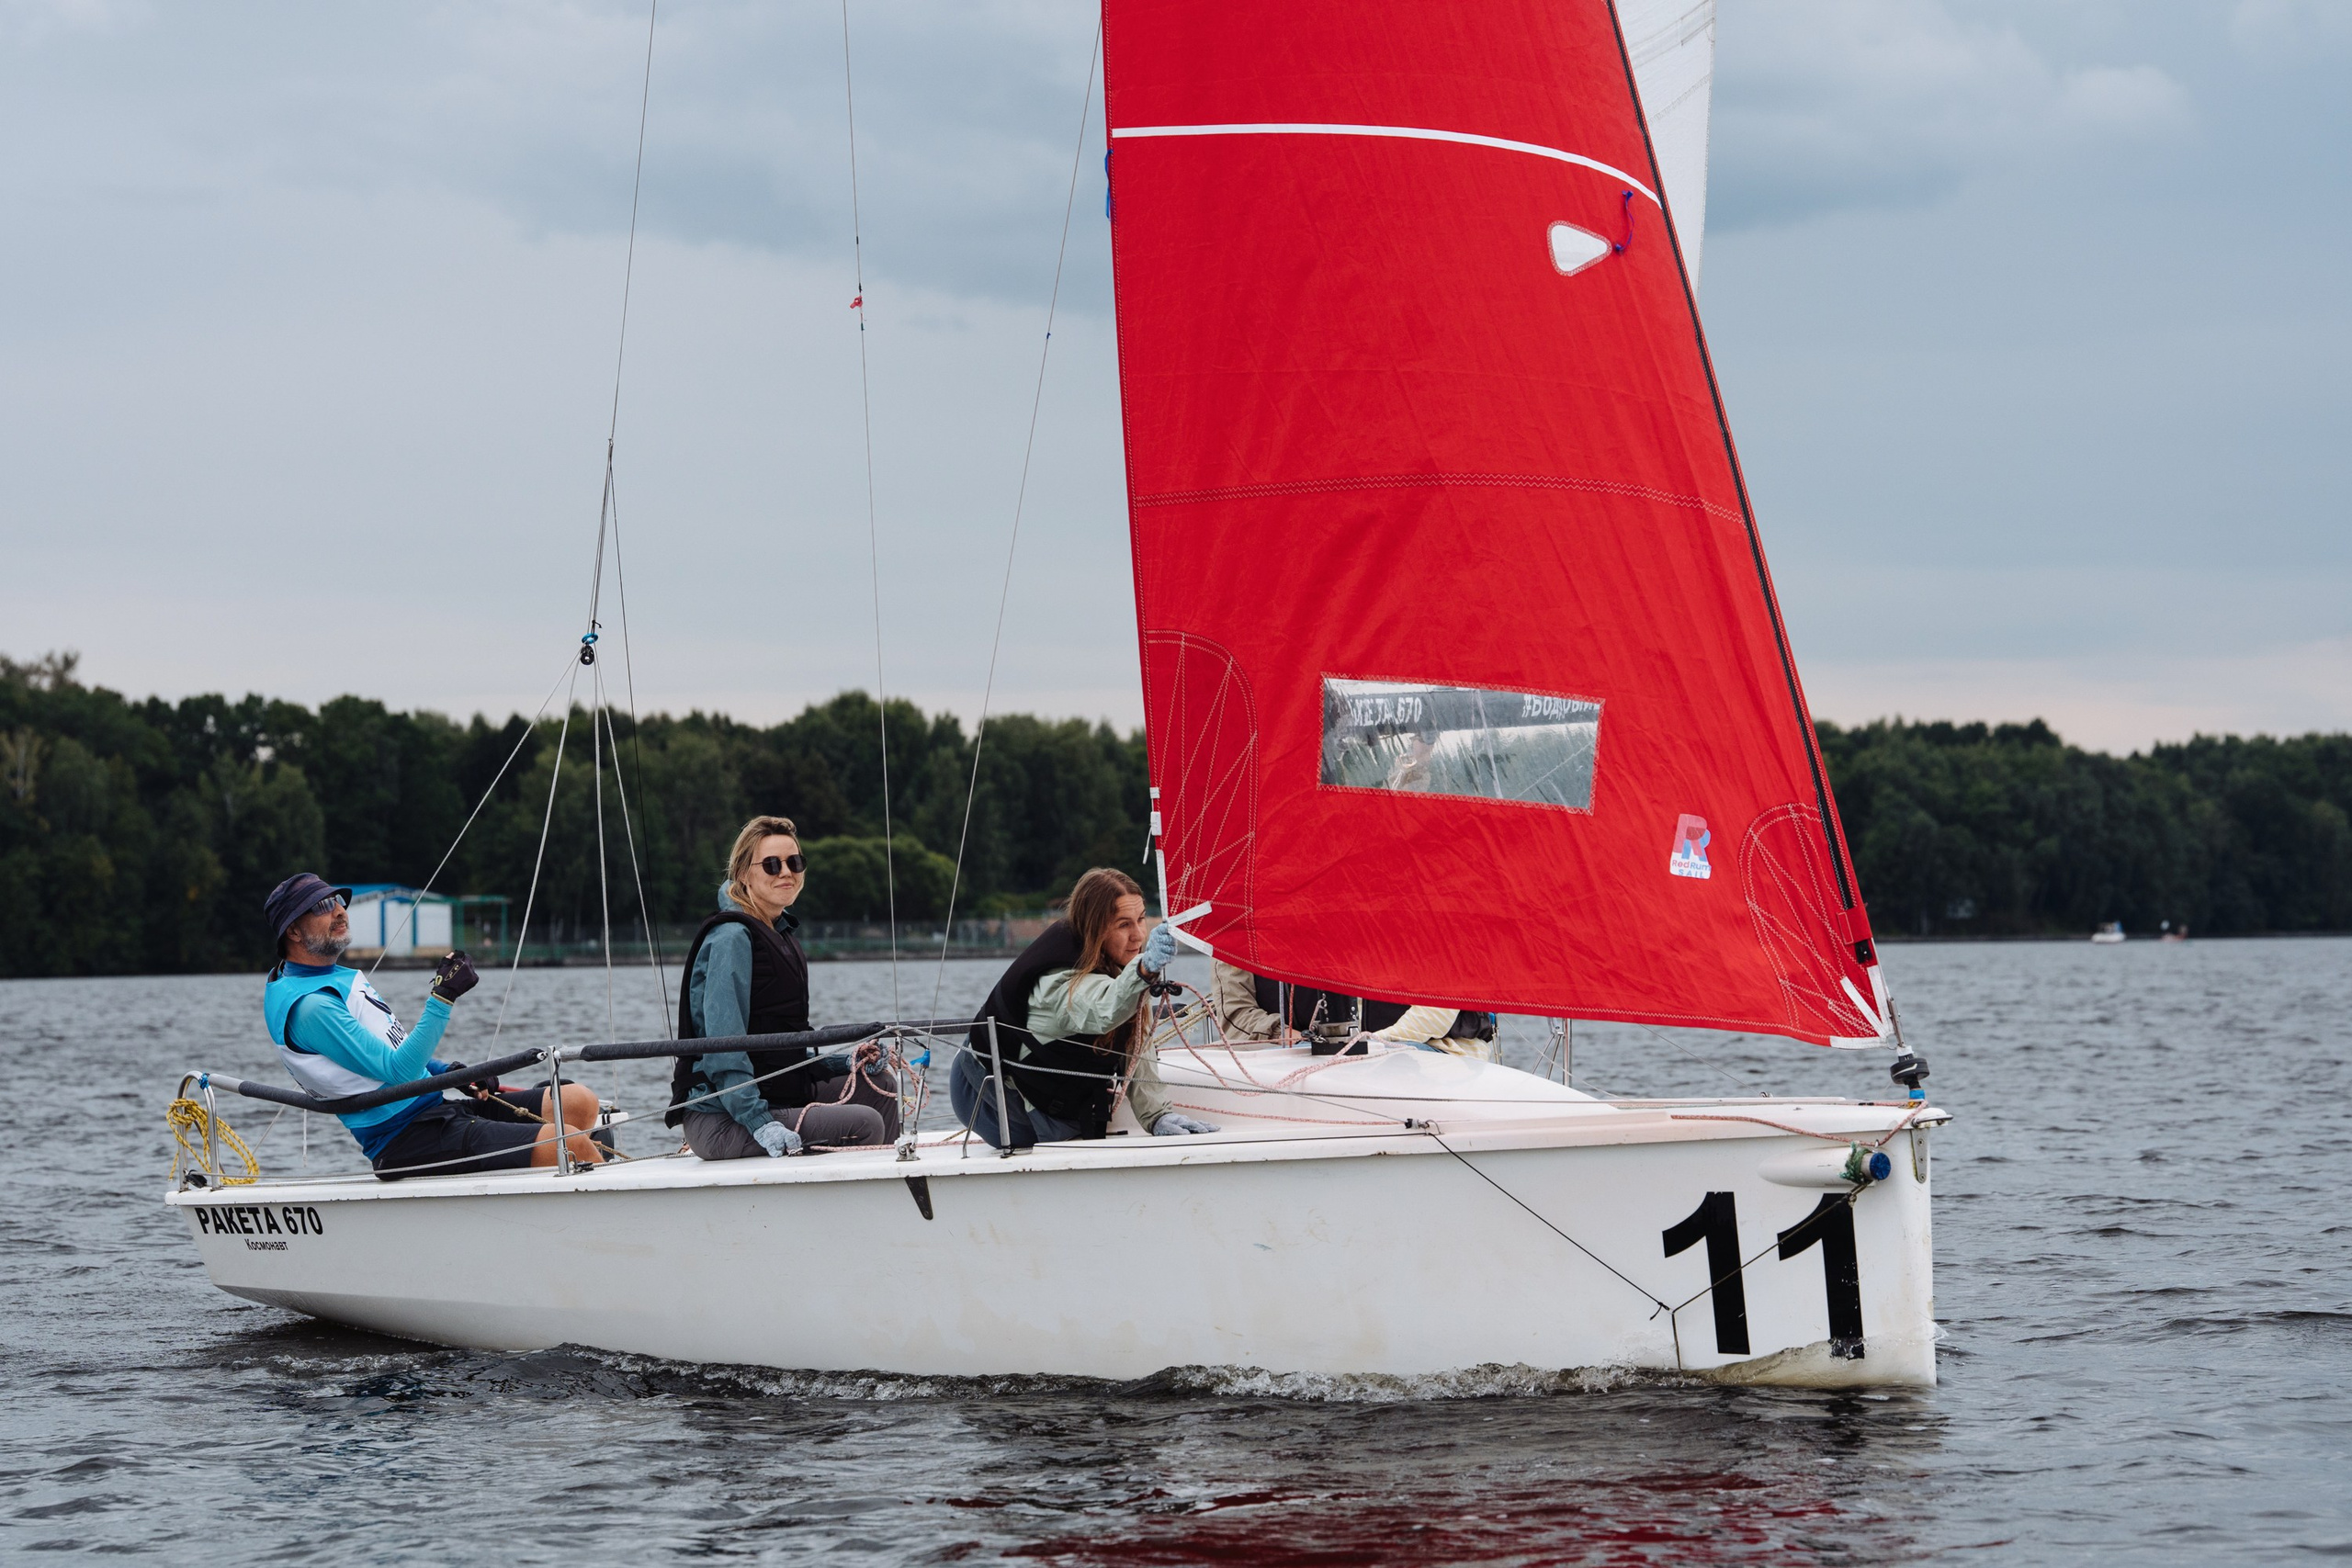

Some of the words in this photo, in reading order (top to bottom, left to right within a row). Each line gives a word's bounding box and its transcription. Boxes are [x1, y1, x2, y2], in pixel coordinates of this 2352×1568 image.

[1397, 696, 1422, 724] 670
[1678, 868, 1704, 879] SAIL
[195, 1207, 283, 1235] РАКЕТА
[282, 1206, 323, 1235] 670
[244, 1238, 289, 1251] Космонавт
[1662, 1191, 1865, 1359] 11
